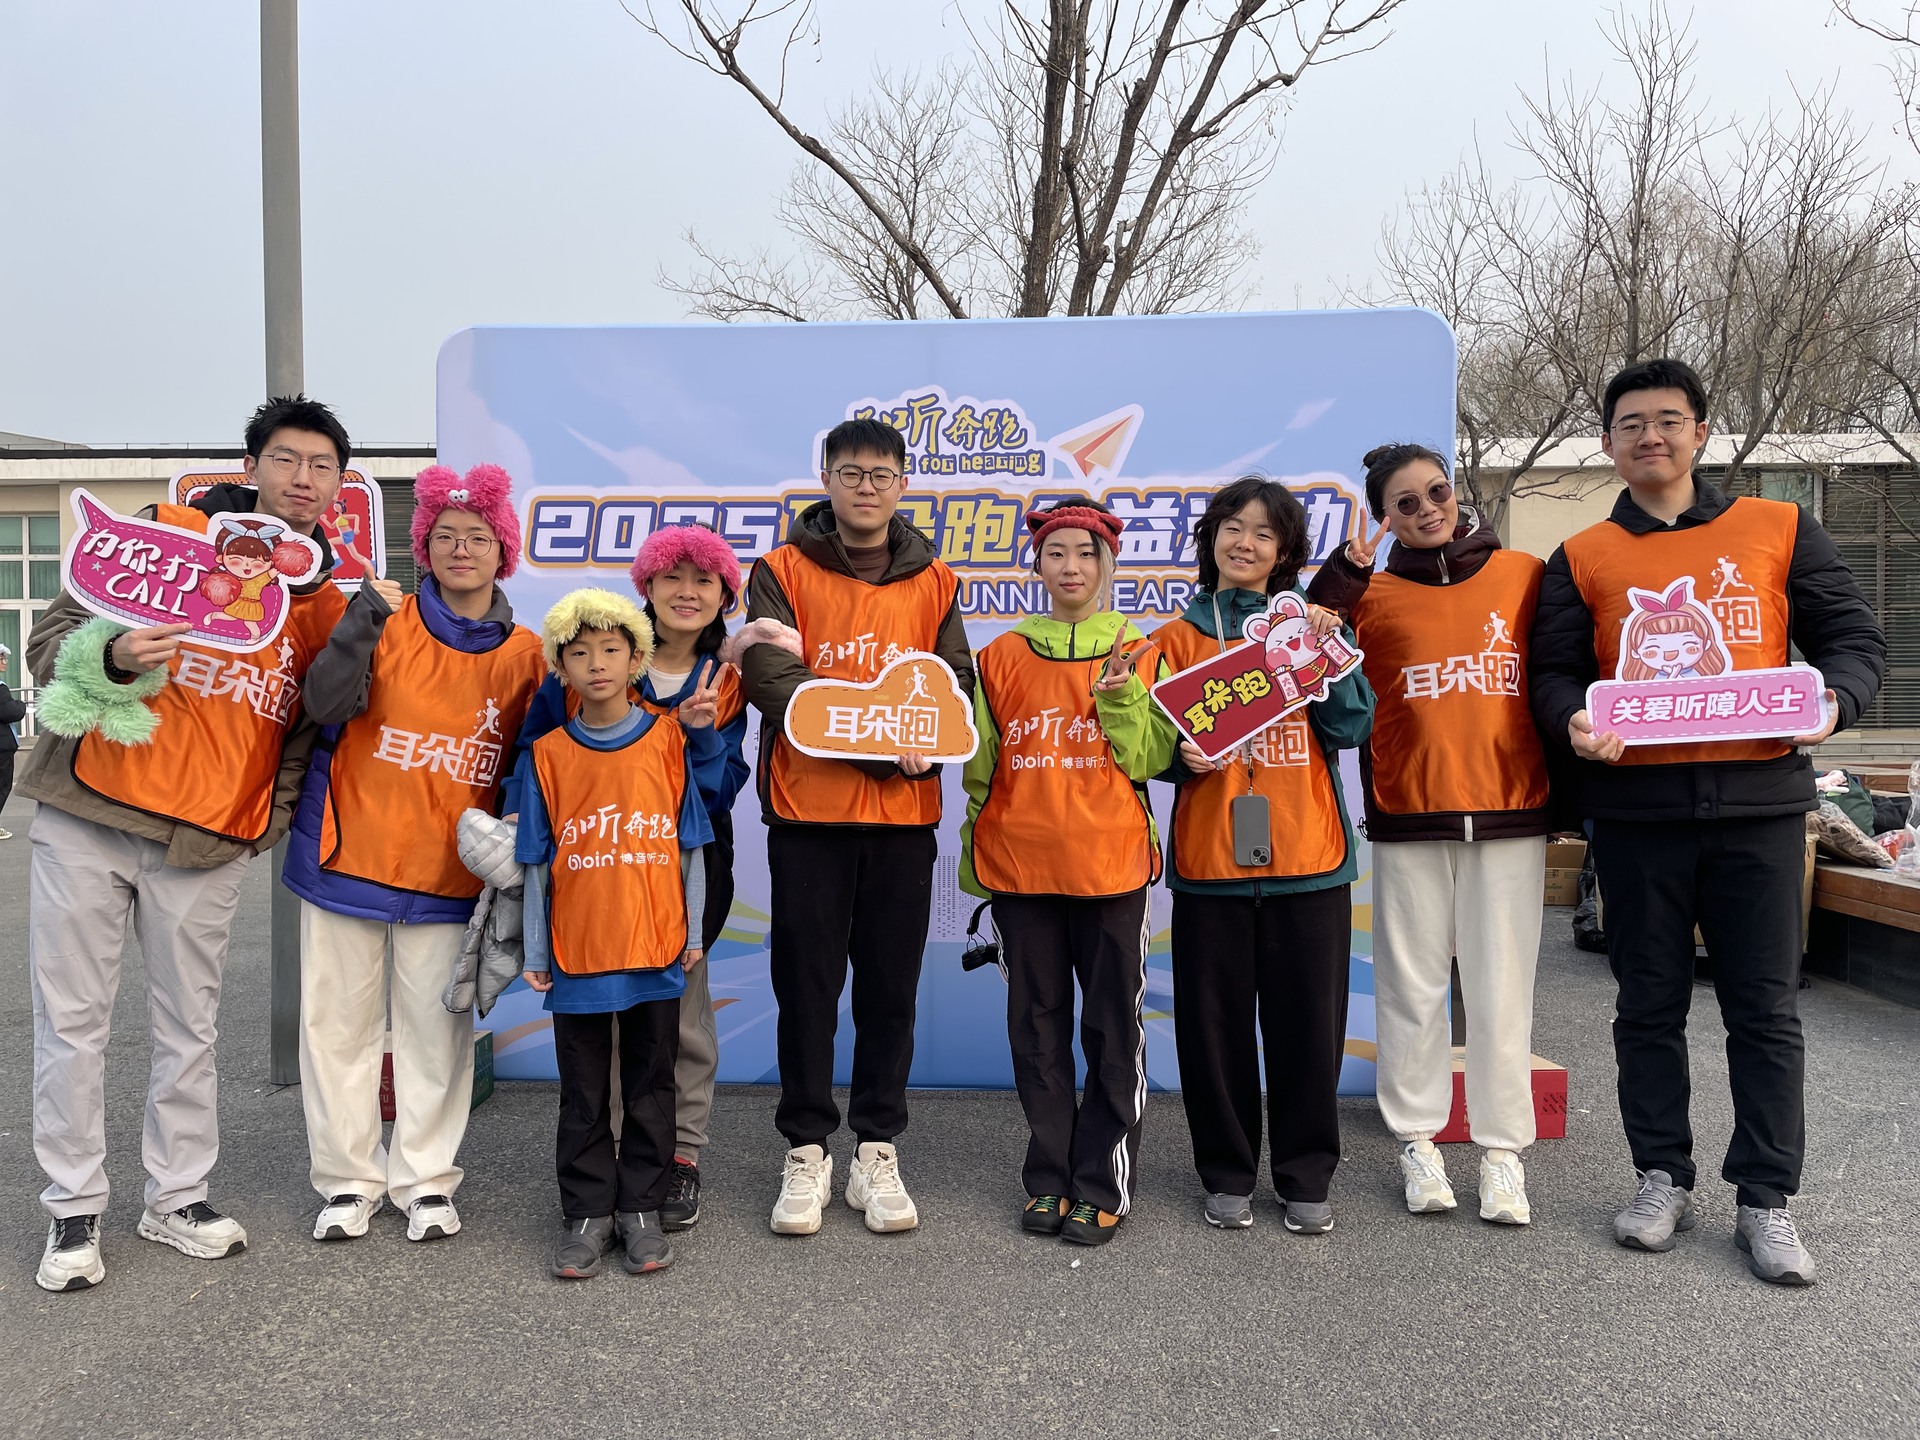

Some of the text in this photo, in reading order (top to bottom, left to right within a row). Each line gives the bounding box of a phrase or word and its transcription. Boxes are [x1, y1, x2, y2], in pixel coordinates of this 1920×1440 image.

[921, 455, 954, 473] for
[961, 452, 1042, 474] hearing
[82, 528, 209, 592] 为你打
[105, 572, 189, 617] CALL
[171, 648, 300, 726] 耳朵跑
[1401, 651, 1520, 700] 耳朵跑
[1183, 669, 1272, 735] 耳朵跑
[1611, 687, 1804, 724] 关爱听障人士
[823, 704, 940, 749] 耳朵跑
[372, 724, 503, 787] 耳朵跑
[1060, 755, 1108, 769] 博音听力
[558, 803, 678, 847] 为听奔跑
[620, 852, 669, 866] 博音听力
